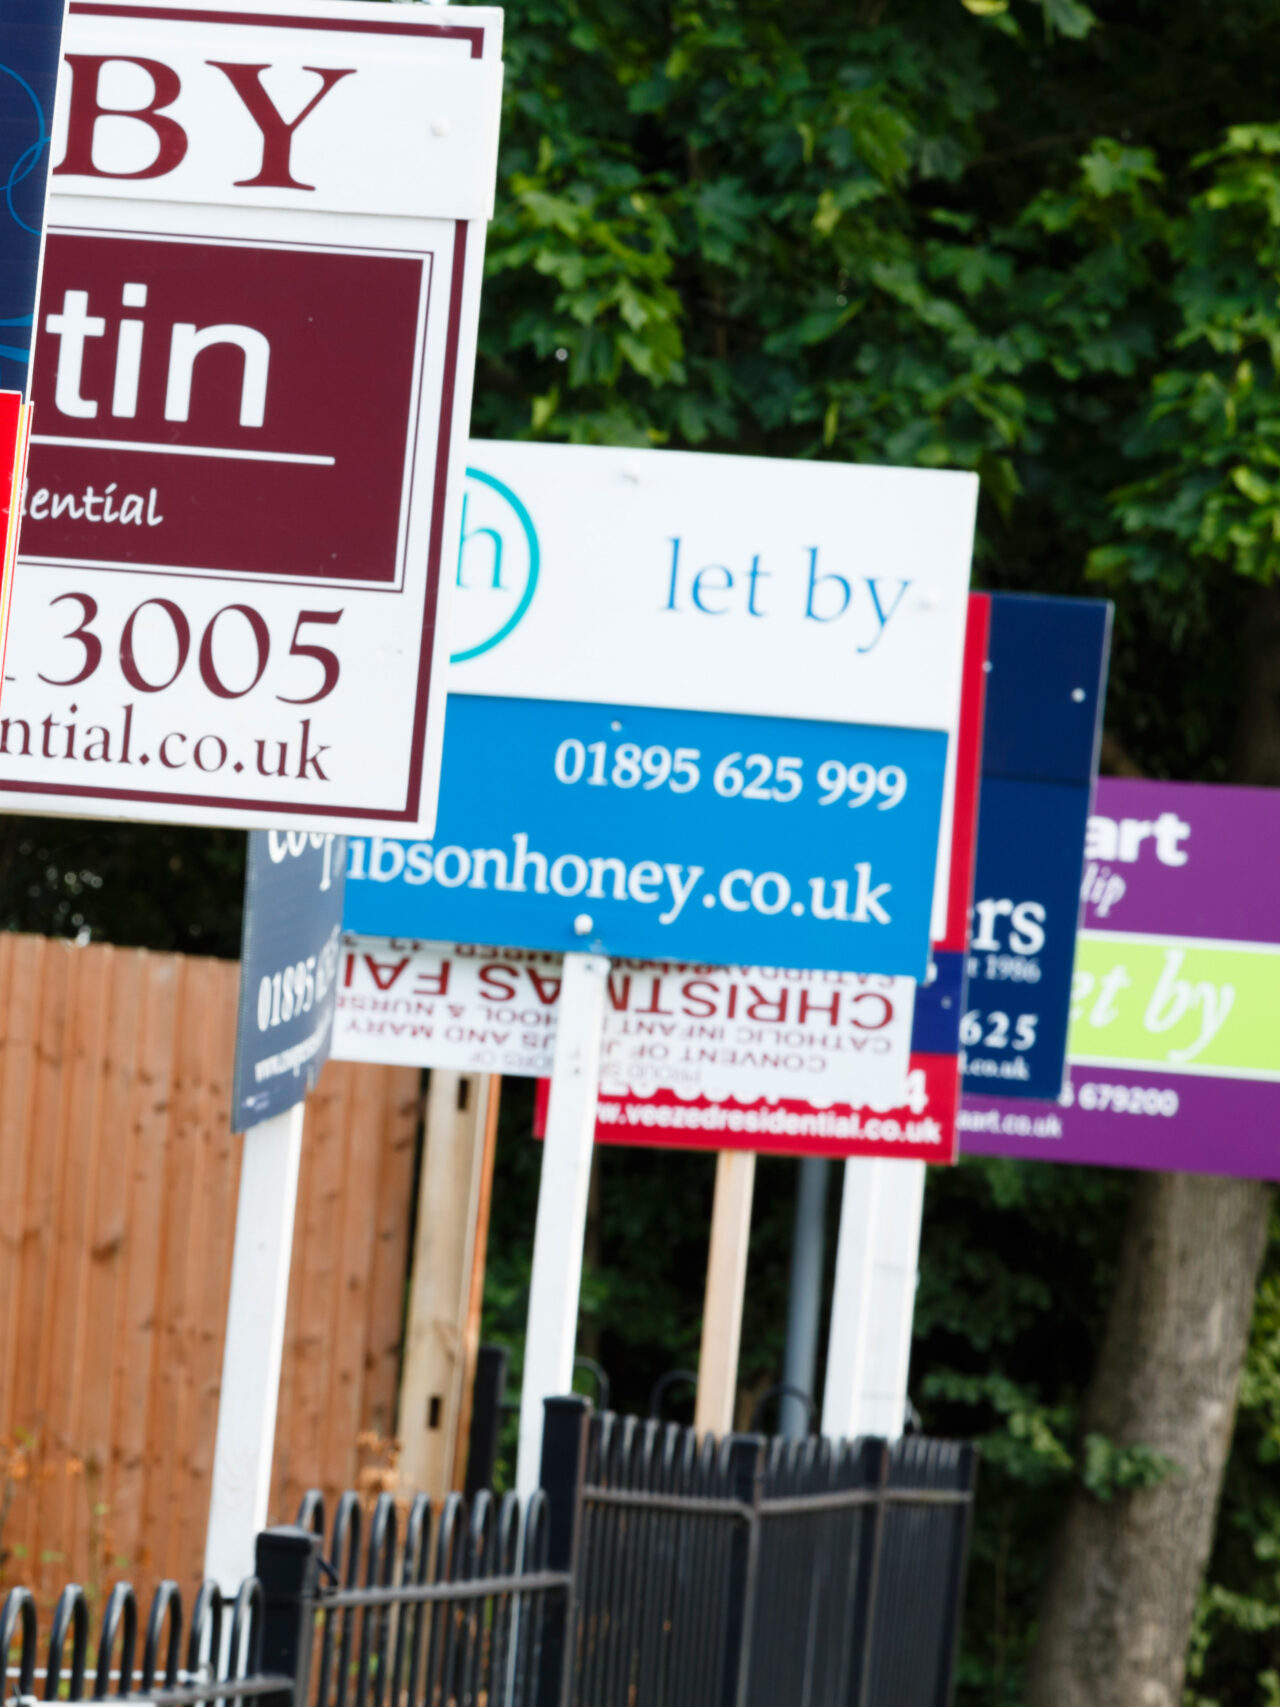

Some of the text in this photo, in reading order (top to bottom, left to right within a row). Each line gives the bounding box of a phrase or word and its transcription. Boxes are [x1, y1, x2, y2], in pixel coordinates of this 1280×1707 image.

[51, 53, 357, 192] BY
[45, 283, 271, 428] tin
[660, 536, 915, 654] let by
[553, 738, 909, 811] 01895 625 999
[346, 833, 892, 926] ibsonhoney.co.uk
[967, 898, 1047, 956] rs
[346, 1015, 433, 1039] MARY
[621, 1017, 726, 1040] INFANT
[958, 1008, 1039, 1051] 625
[1143, 948, 1236, 1064] by
[444, 1023, 510, 1046] AND
[633, 1042, 671, 1060] OF
[735, 1026, 893, 1055] CATHOLIC
[683, 1046, 828, 1074] CONVENT
